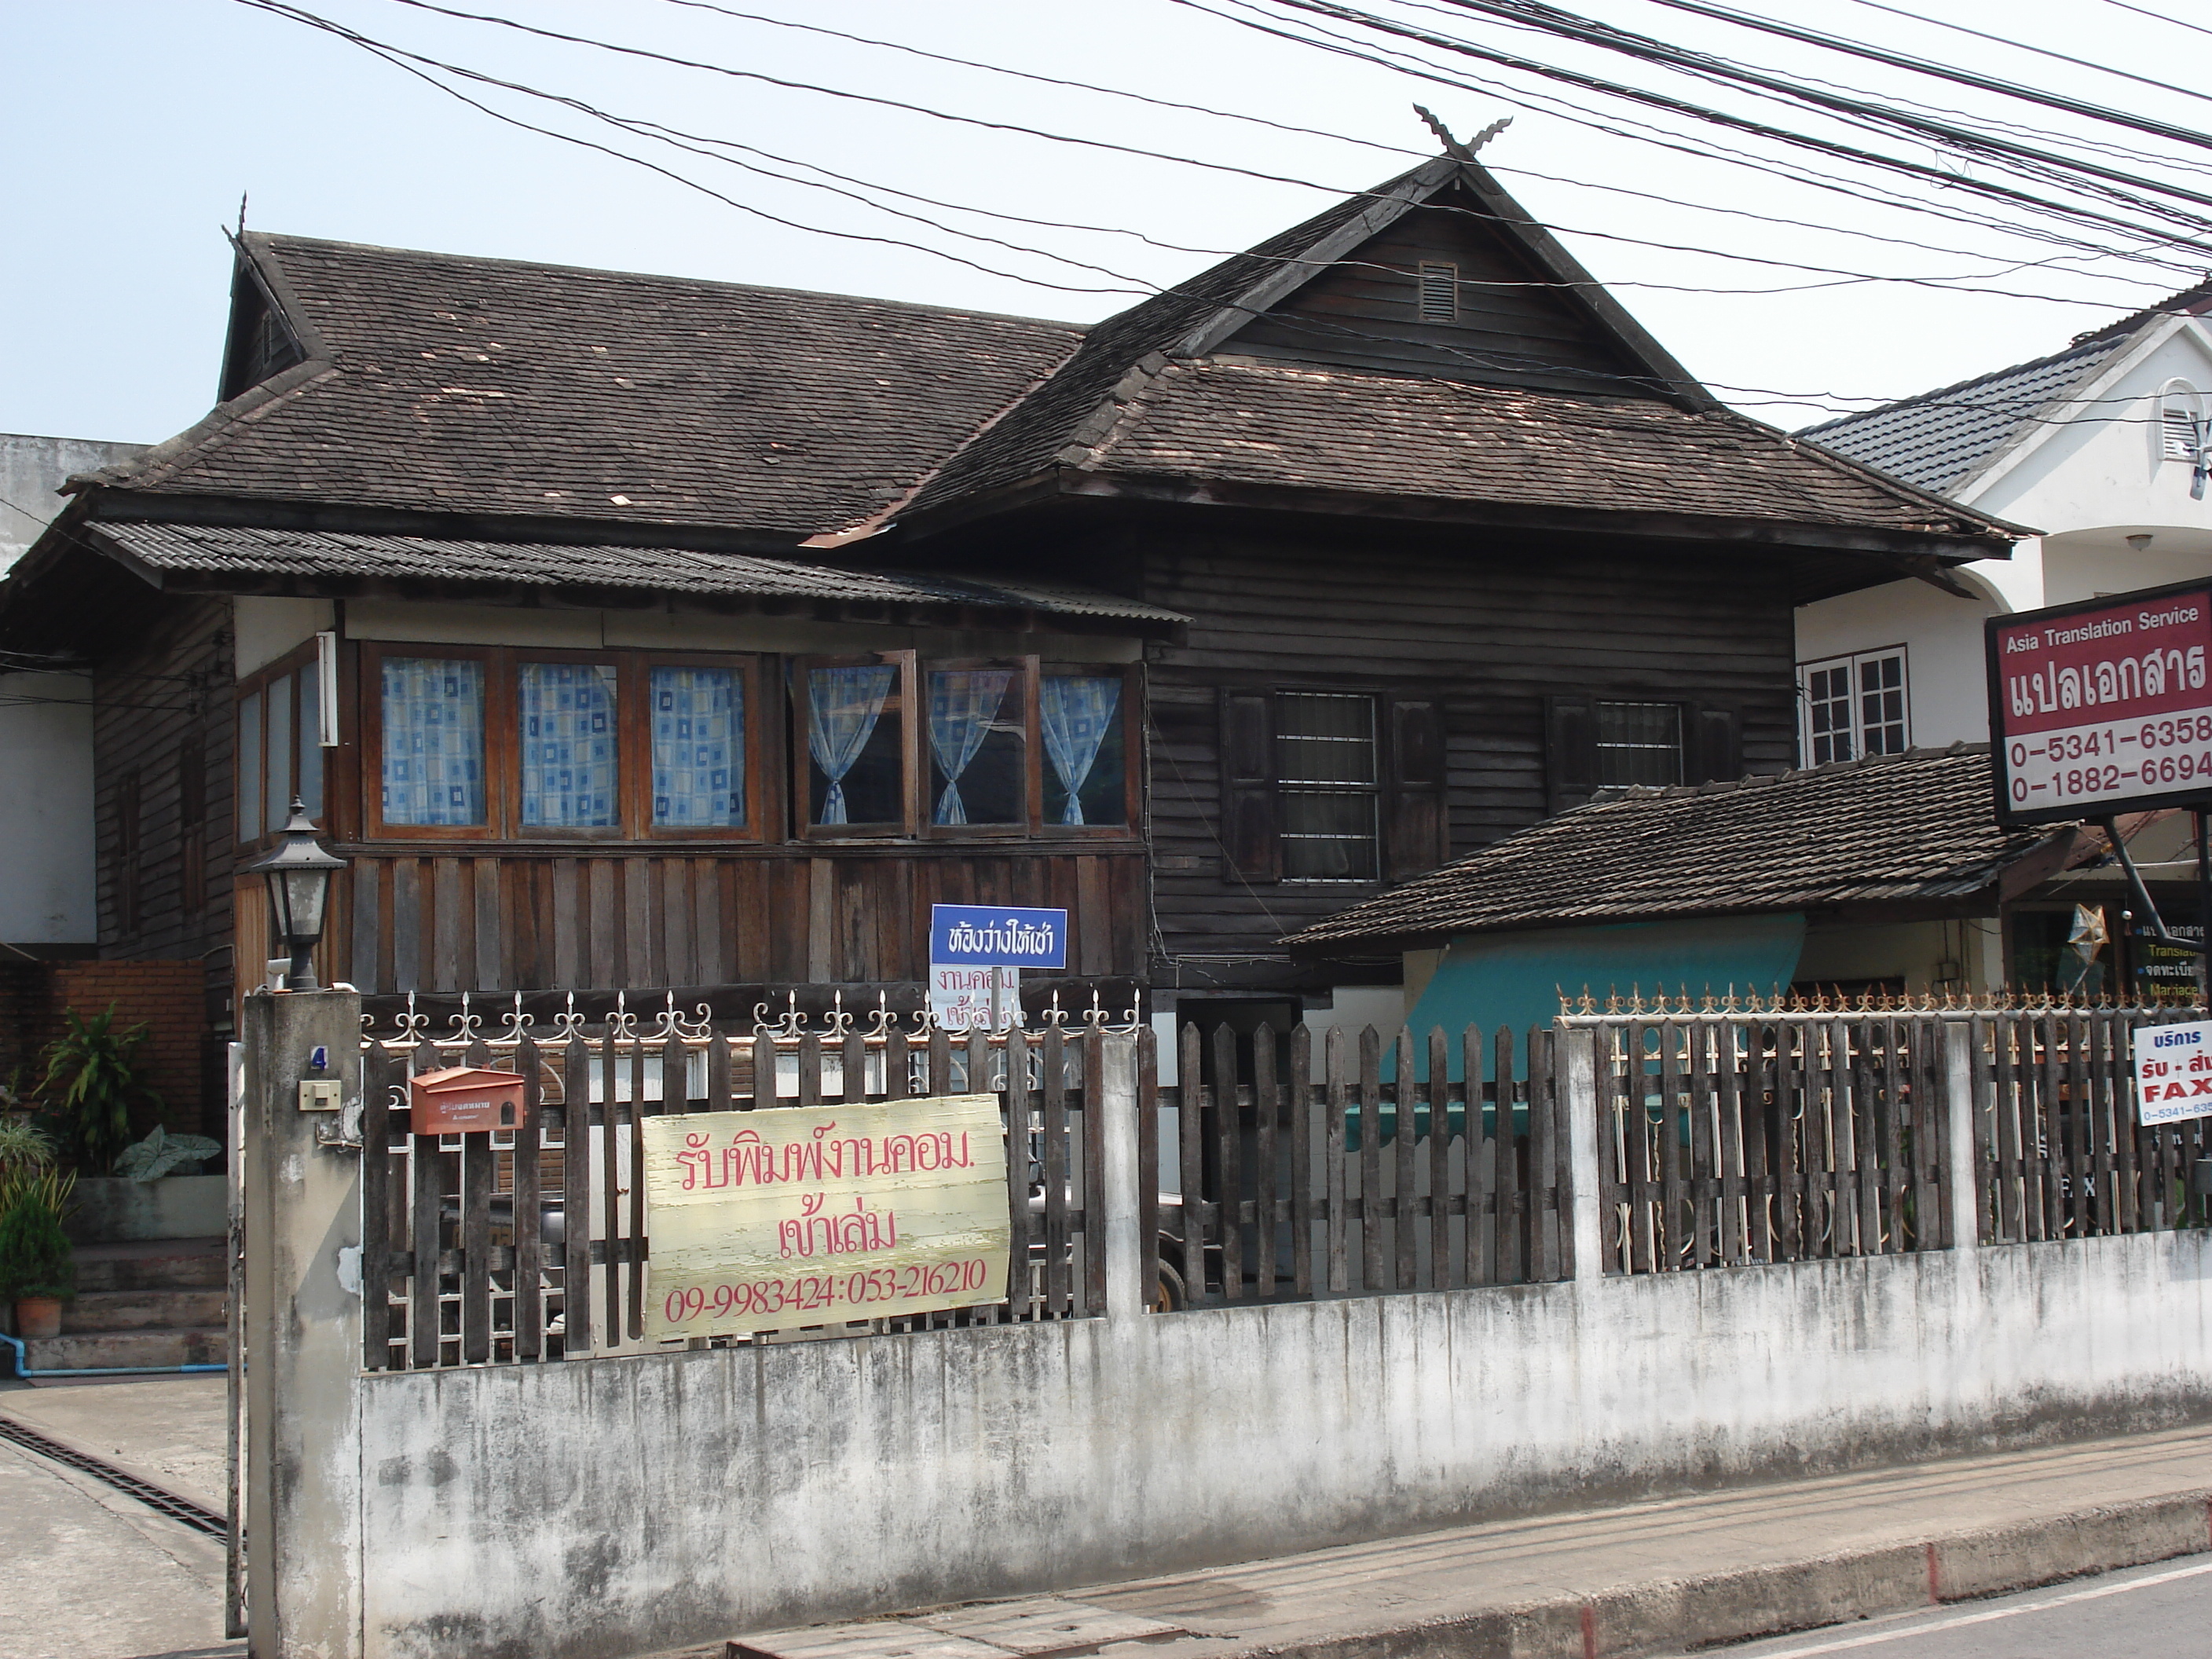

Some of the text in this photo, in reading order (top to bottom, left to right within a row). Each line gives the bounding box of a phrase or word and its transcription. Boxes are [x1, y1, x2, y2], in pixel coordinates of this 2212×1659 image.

[2006, 606, 2199, 654] Asia Translation Service
[2009, 645, 2207, 717] แปลเอกสาร
[2011, 715, 2212, 767] 0-5341-6358
[2012, 751, 2212, 802] 0-1882-6694
[949, 919, 1053, 955] ห้องว่างให้เช่า
[312, 1047, 327, 1071] 4
[2154, 1031, 2201, 1048] บริการ
[2142, 1058, 2168, 1079] รับ
[2144, 1077, 2212, 1103] FAX
[676, 1121, 975, 1191] รับพิมพ์งานคอม.
[778, 1193, 897, 1258] เข้าเล่ม
[665, 1258, 987, 1324] 09-9983424:053-216210
